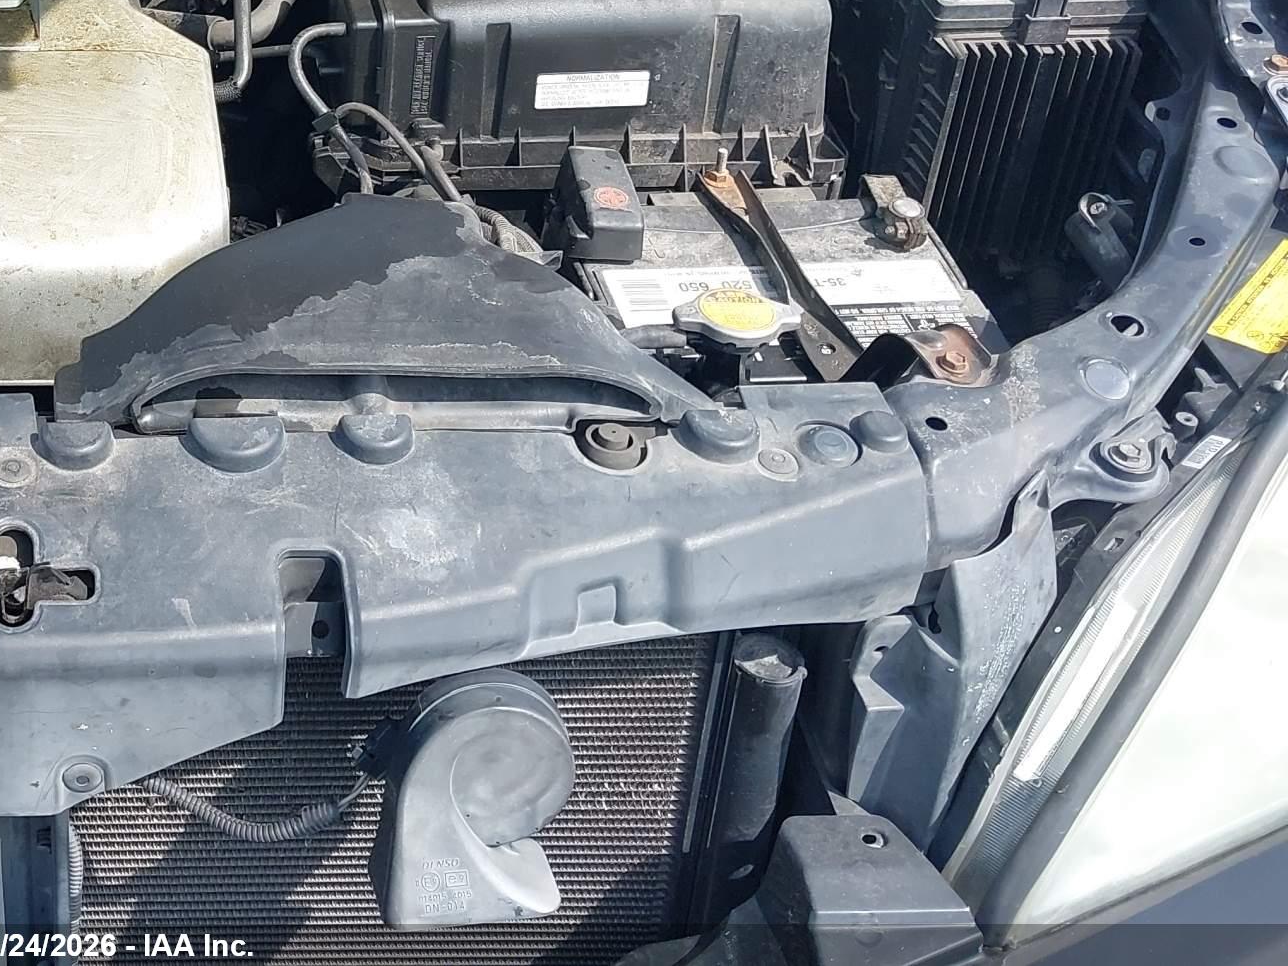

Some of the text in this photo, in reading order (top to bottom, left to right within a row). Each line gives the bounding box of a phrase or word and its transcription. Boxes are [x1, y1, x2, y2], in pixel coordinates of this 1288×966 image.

[566, 73, 620, 82] NORMALIZATION
[678, 281, 710, 292] 650
[425, 900, 466, 914] DN-014
